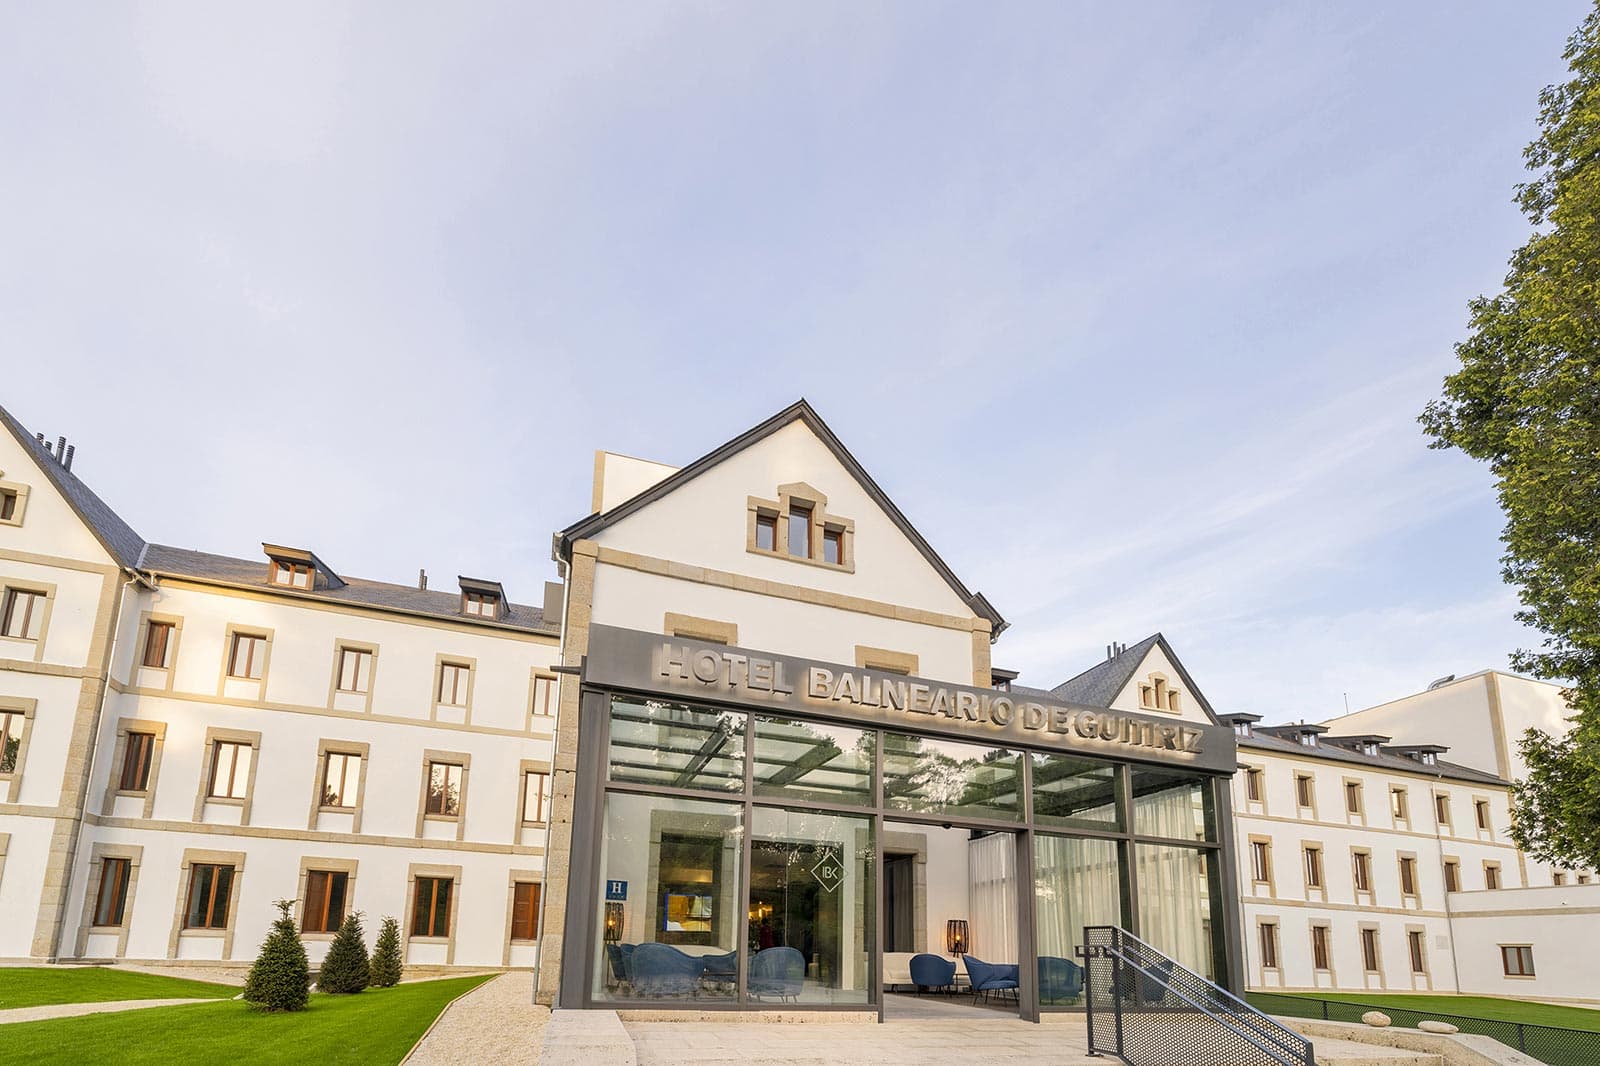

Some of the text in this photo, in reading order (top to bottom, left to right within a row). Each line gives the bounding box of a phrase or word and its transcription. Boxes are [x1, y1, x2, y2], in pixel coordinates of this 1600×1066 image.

[661, 643, 1204, 753] HOTEL BALNEARIO DE GUITIRIZ
[612, 882, 622, 893] H
